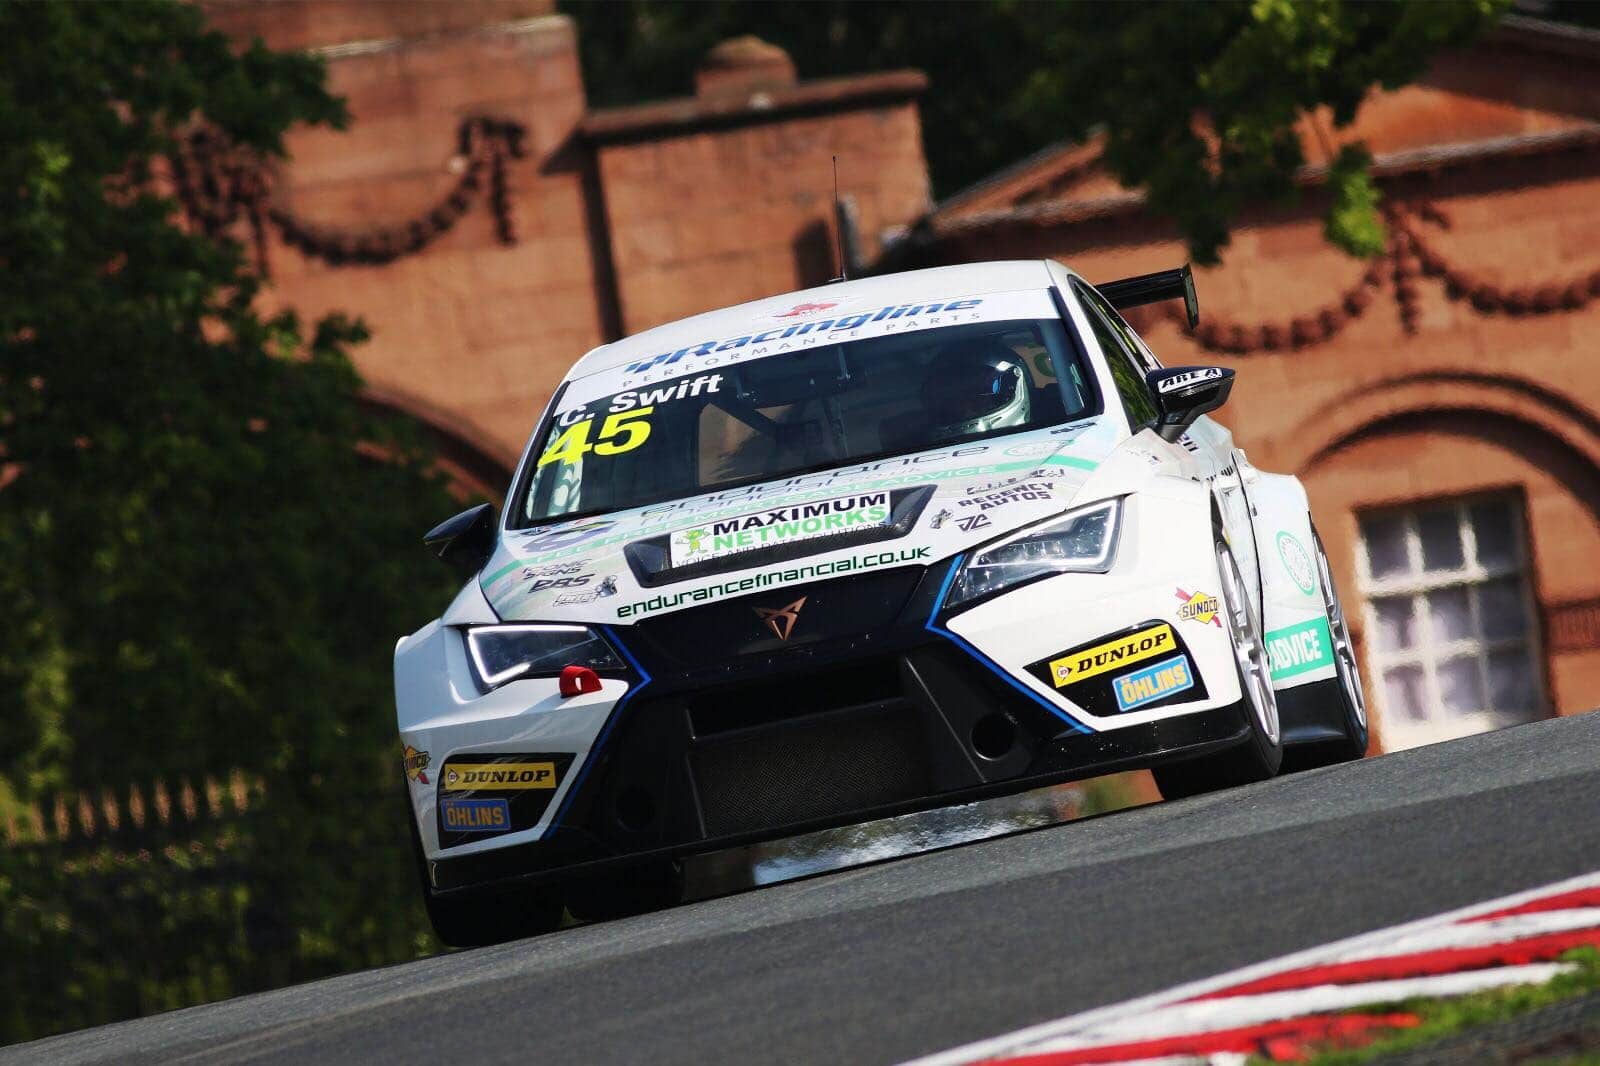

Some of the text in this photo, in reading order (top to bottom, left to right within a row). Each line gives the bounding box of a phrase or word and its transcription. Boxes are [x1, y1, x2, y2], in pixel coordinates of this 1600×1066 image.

[623, 312, 981, 387] PERFORMANCE PARTS
[664, 299, 983, 364] Racingline
[559, 373, 723, 427] C. Swift
[537, 406, 654, 468] 45
[713, 493, 886, 536] MAXIMUM
[958, 482, 1055, 507] REGENCY
[980, 491, 1052, 511] AUTOS
[713, 505, 887, 551] NETWORKS
[616, 546, 930, 618] endurancefinancial.co.uk
[1181, 599, 1218, 618] SUNOCO
[1077, 632, 1168, 673] DUNLOP
[1269, 629, 1323, 672] ADVICE
[1120, 663, 1188, 704] ÖHLINS
[463, 769, 550, 783] DUNLOP
[446, 800, 505, 826] ÖHLINS
